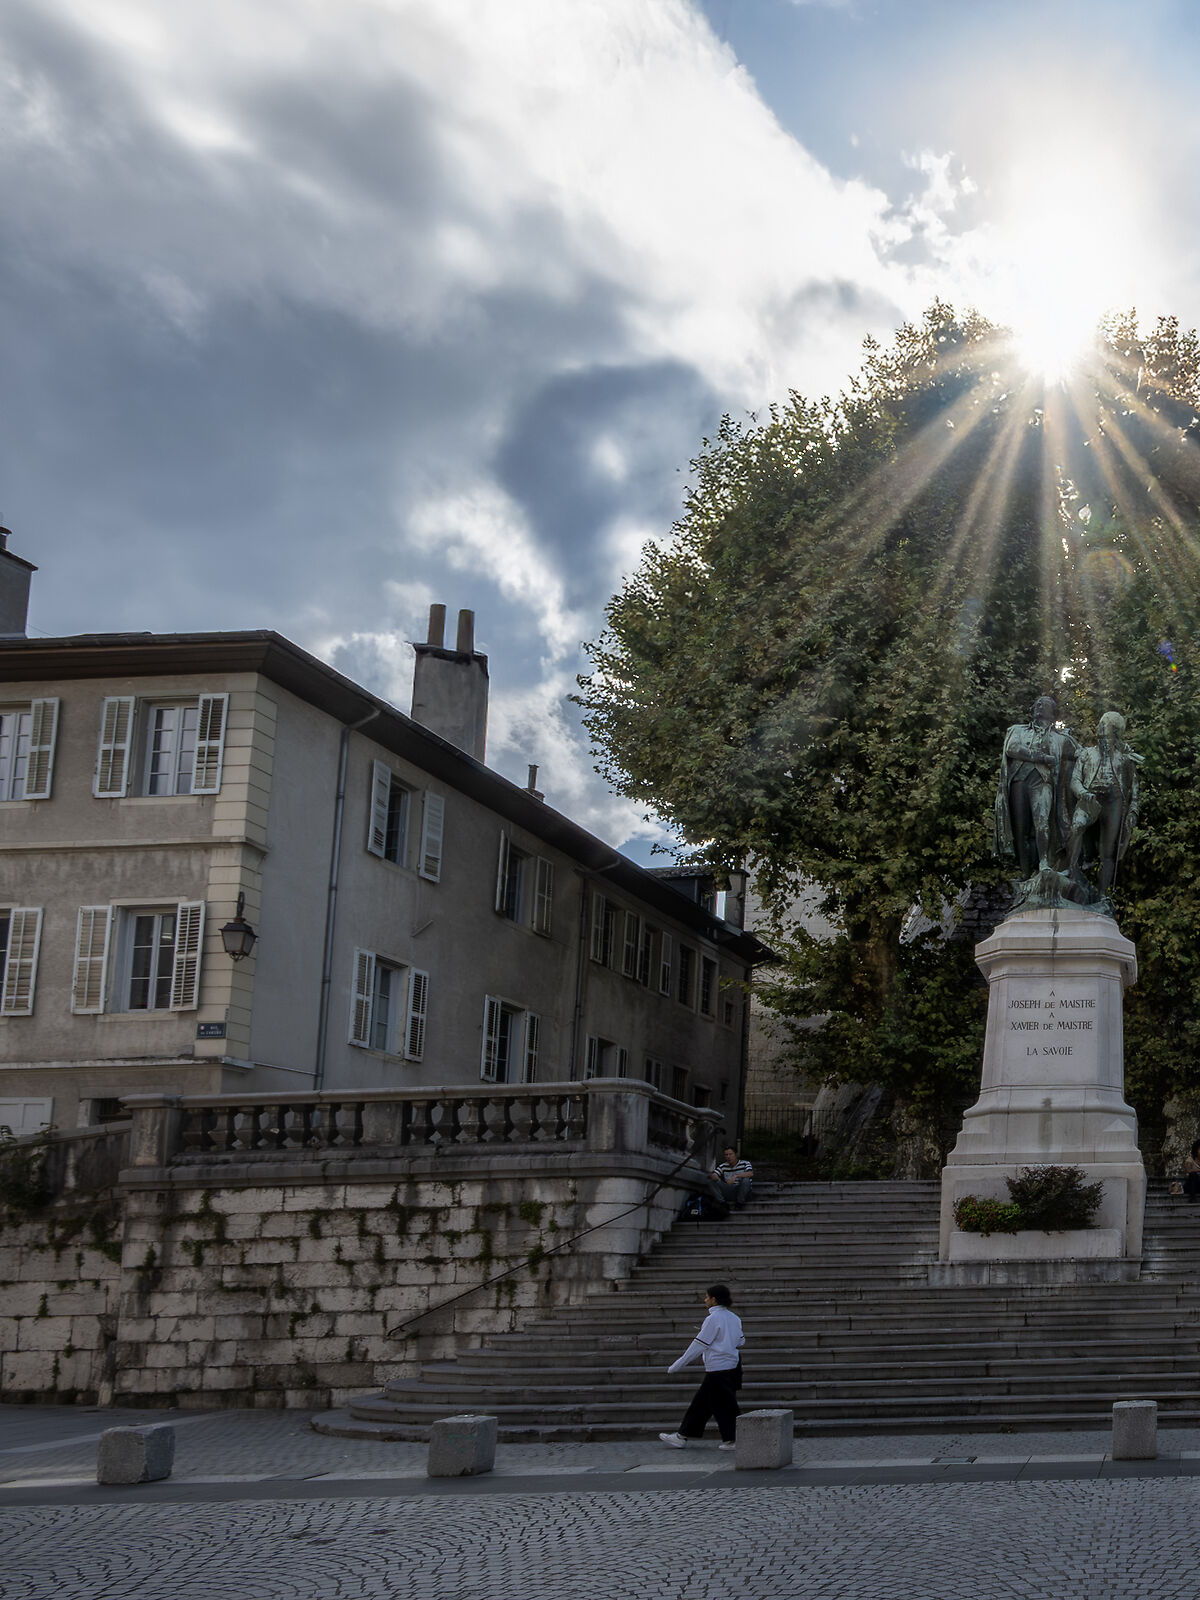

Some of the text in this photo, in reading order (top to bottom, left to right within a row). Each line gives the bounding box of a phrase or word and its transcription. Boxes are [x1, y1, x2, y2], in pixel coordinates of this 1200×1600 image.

[1008, 1000, 1041, 1009] JOSEPH
[1059, 999, 1096, 1009] MAISTRE
[1011, 1021, 1039, 1031] XAVIER
[1057, 1021, 1093, 1030] MAISTRE
[1026, 1046, 1073, 1056] LA SAVOIE
